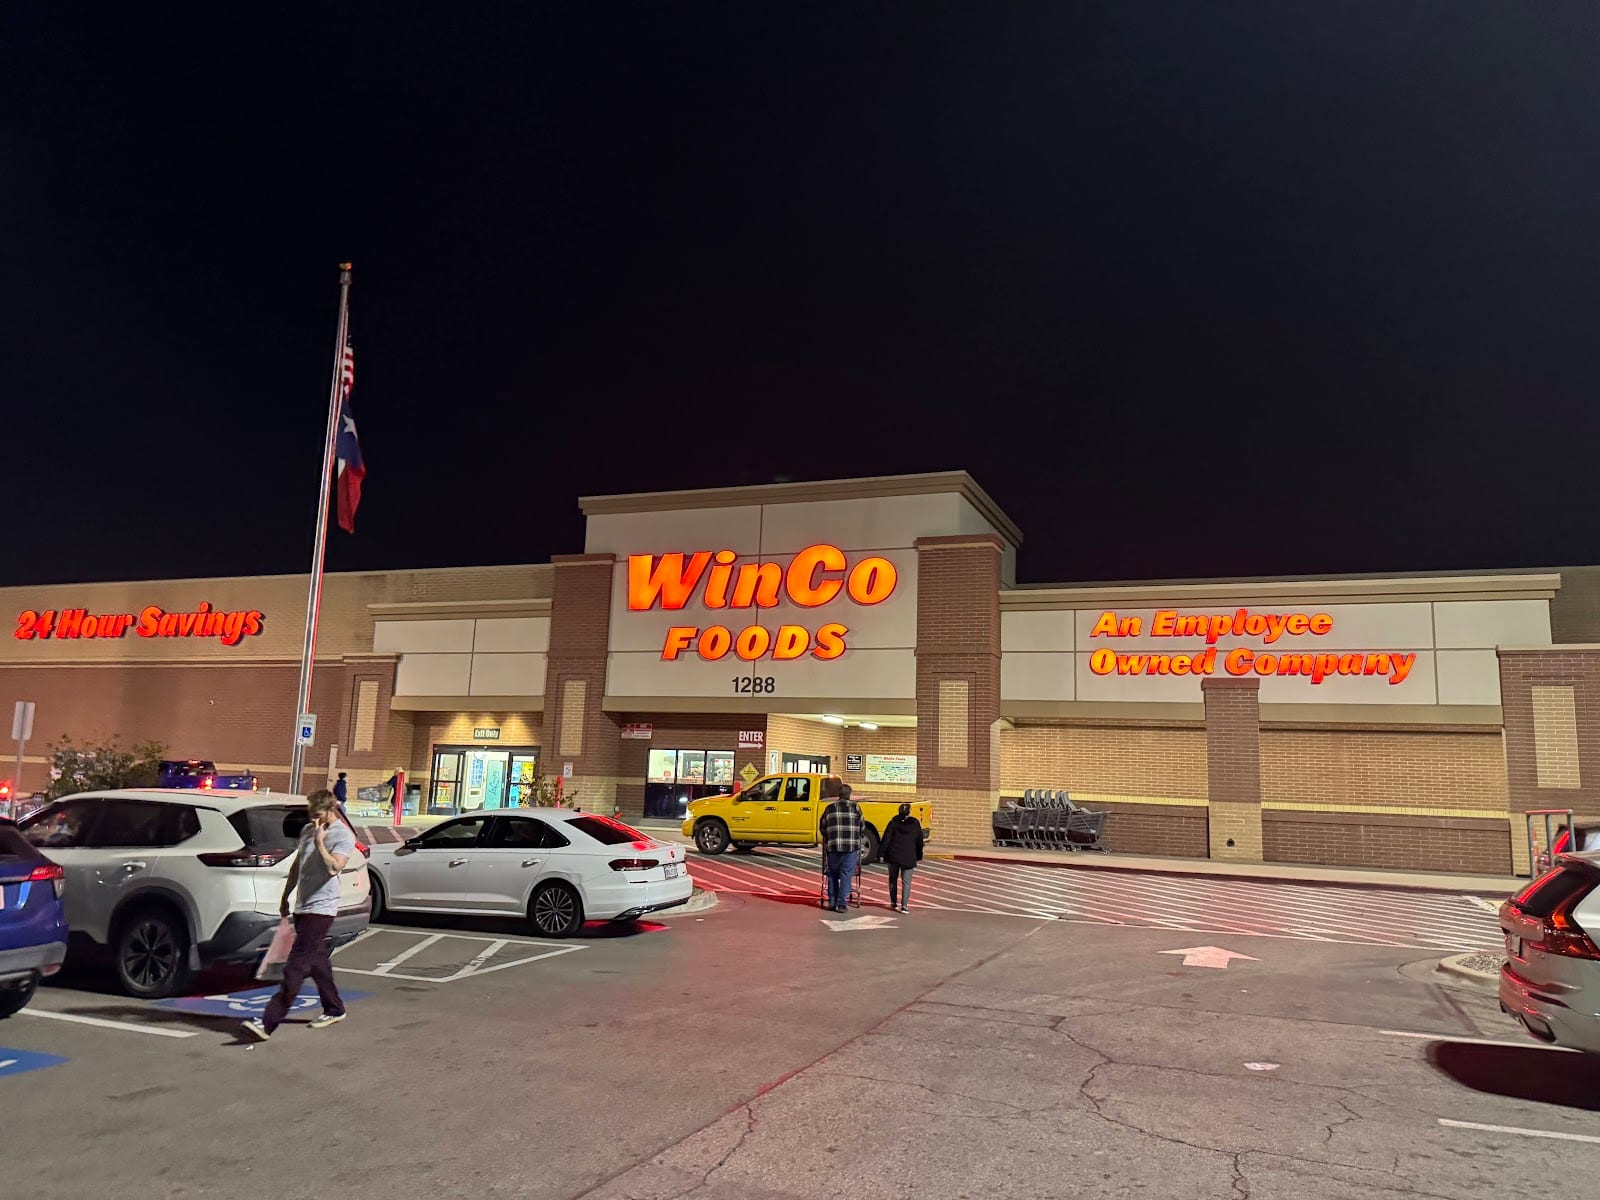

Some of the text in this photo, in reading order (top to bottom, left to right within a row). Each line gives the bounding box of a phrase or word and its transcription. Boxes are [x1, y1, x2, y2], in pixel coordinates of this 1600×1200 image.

[627, 544, 897, 610] WinCo
[15, 602, 264, 645] 24 Hour Savings
[1090, 609, 1333, 643] An Employee
[661, 623, 849, 661] FOODS
[1090, 647, 1416, 684] Owned Company
[732, 676, 775, 693] 1288
[475, 729, 499, 739] Exit Only
[739, 731, 763, 741] ENTER
